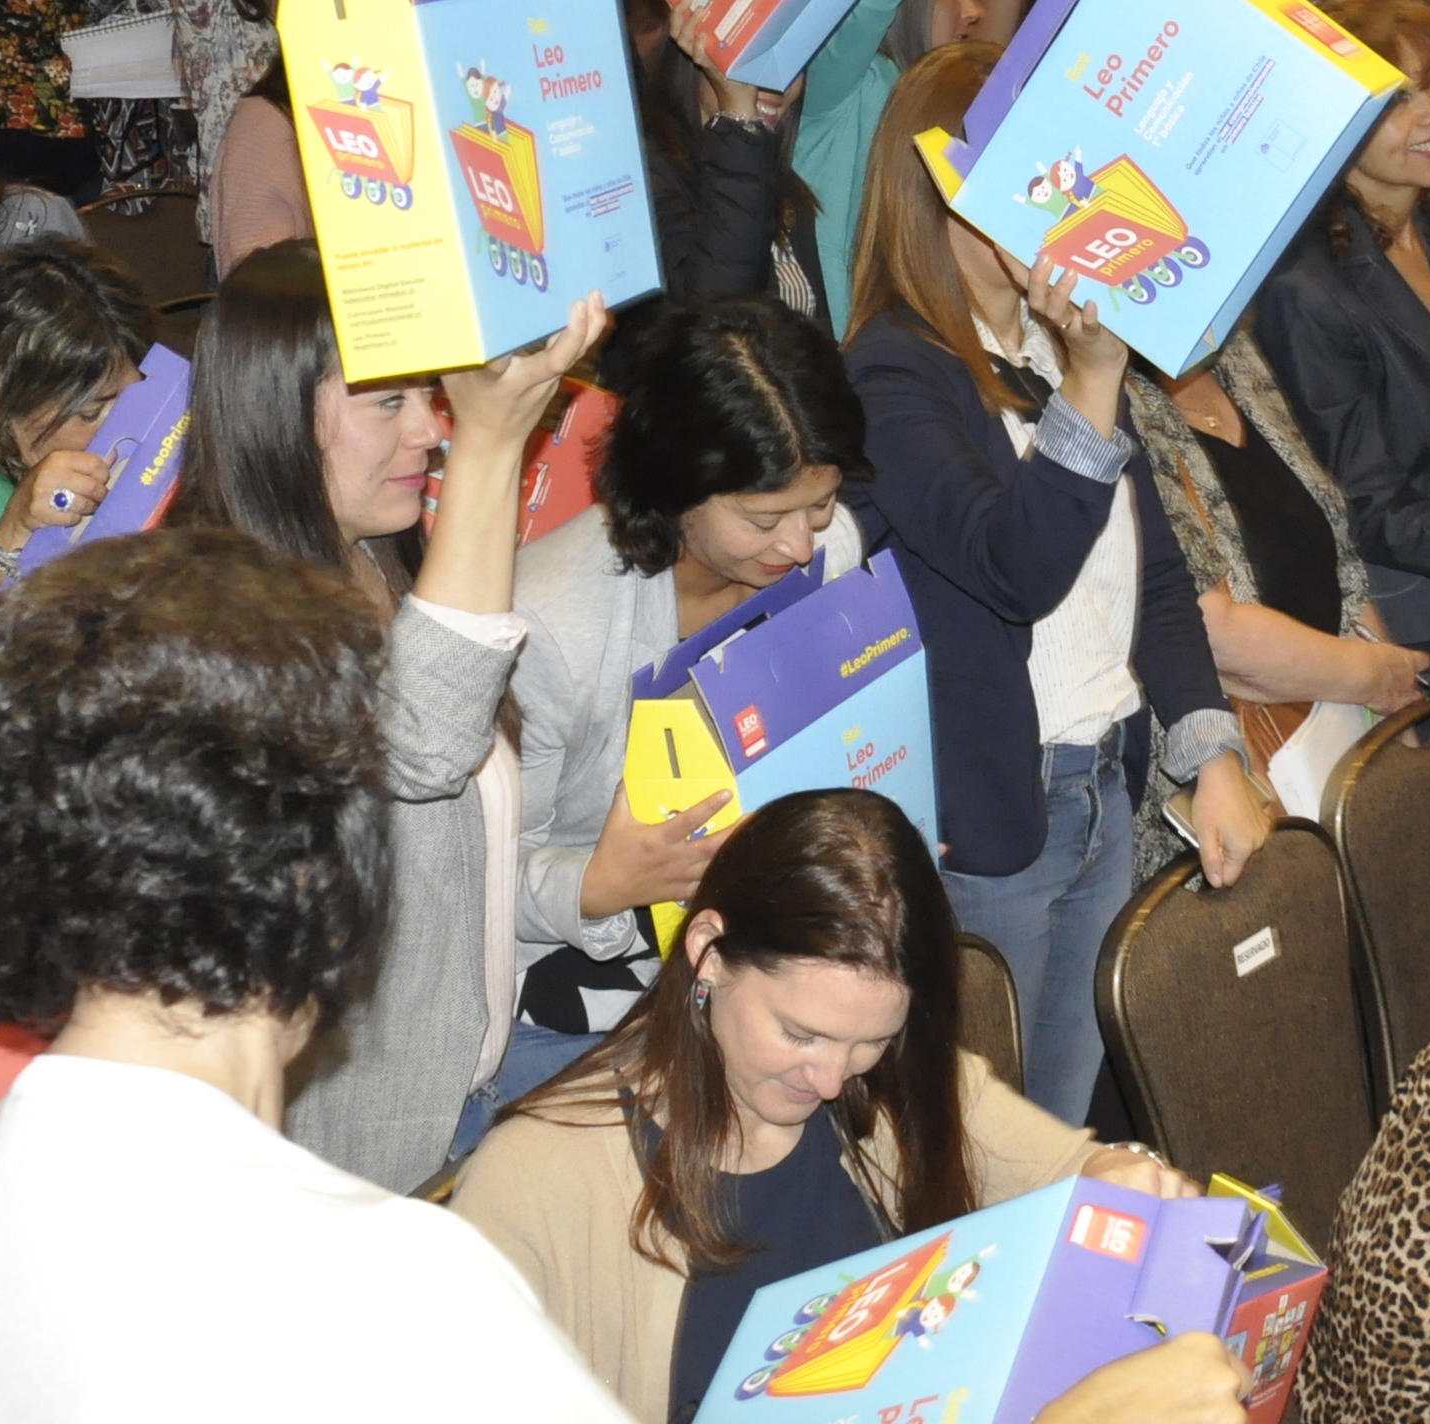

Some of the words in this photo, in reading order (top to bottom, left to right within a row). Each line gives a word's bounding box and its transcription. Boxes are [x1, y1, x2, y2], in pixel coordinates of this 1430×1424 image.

[533, 44, 564, 68] Leo
[1065, 52, 1091, 83] Set
[1083, 54, 1123, 100] Leo
[1105, 21, 1180, 118] Primero
[539, 70, 602, 102] Primero
[1143, 71, 1193, 141] Comunicación
[1134, 89, 1167, 134] Lenguaje
[1186, 157, 1197, 170] Que
[1196, 136, 1211, 161] todos
[1252, 55, 1266, 73] Chile
[324, 126, 378, 158] LEO
[337, 148, 385, 171] primero
[1195, 143, 1218, 176] aprendan
[467, 166, 512, 213] LEO
[481, 202, 521, 230] primero
[1070, 226, 1138, 272] LEO
[1100, 237, 1154, 277] primero
[840, 628, 908, 678] #LeoPrimero
[738, 714, 757, 732] LEO
[846, 742, 875, 772] Leo
[851, 745, 908, 791] Primero
[1106, 1218, 1134, 1254] LEO
[806, 1281, 869, 1354] primero
[830, 1261, 908, 1342] LEO
